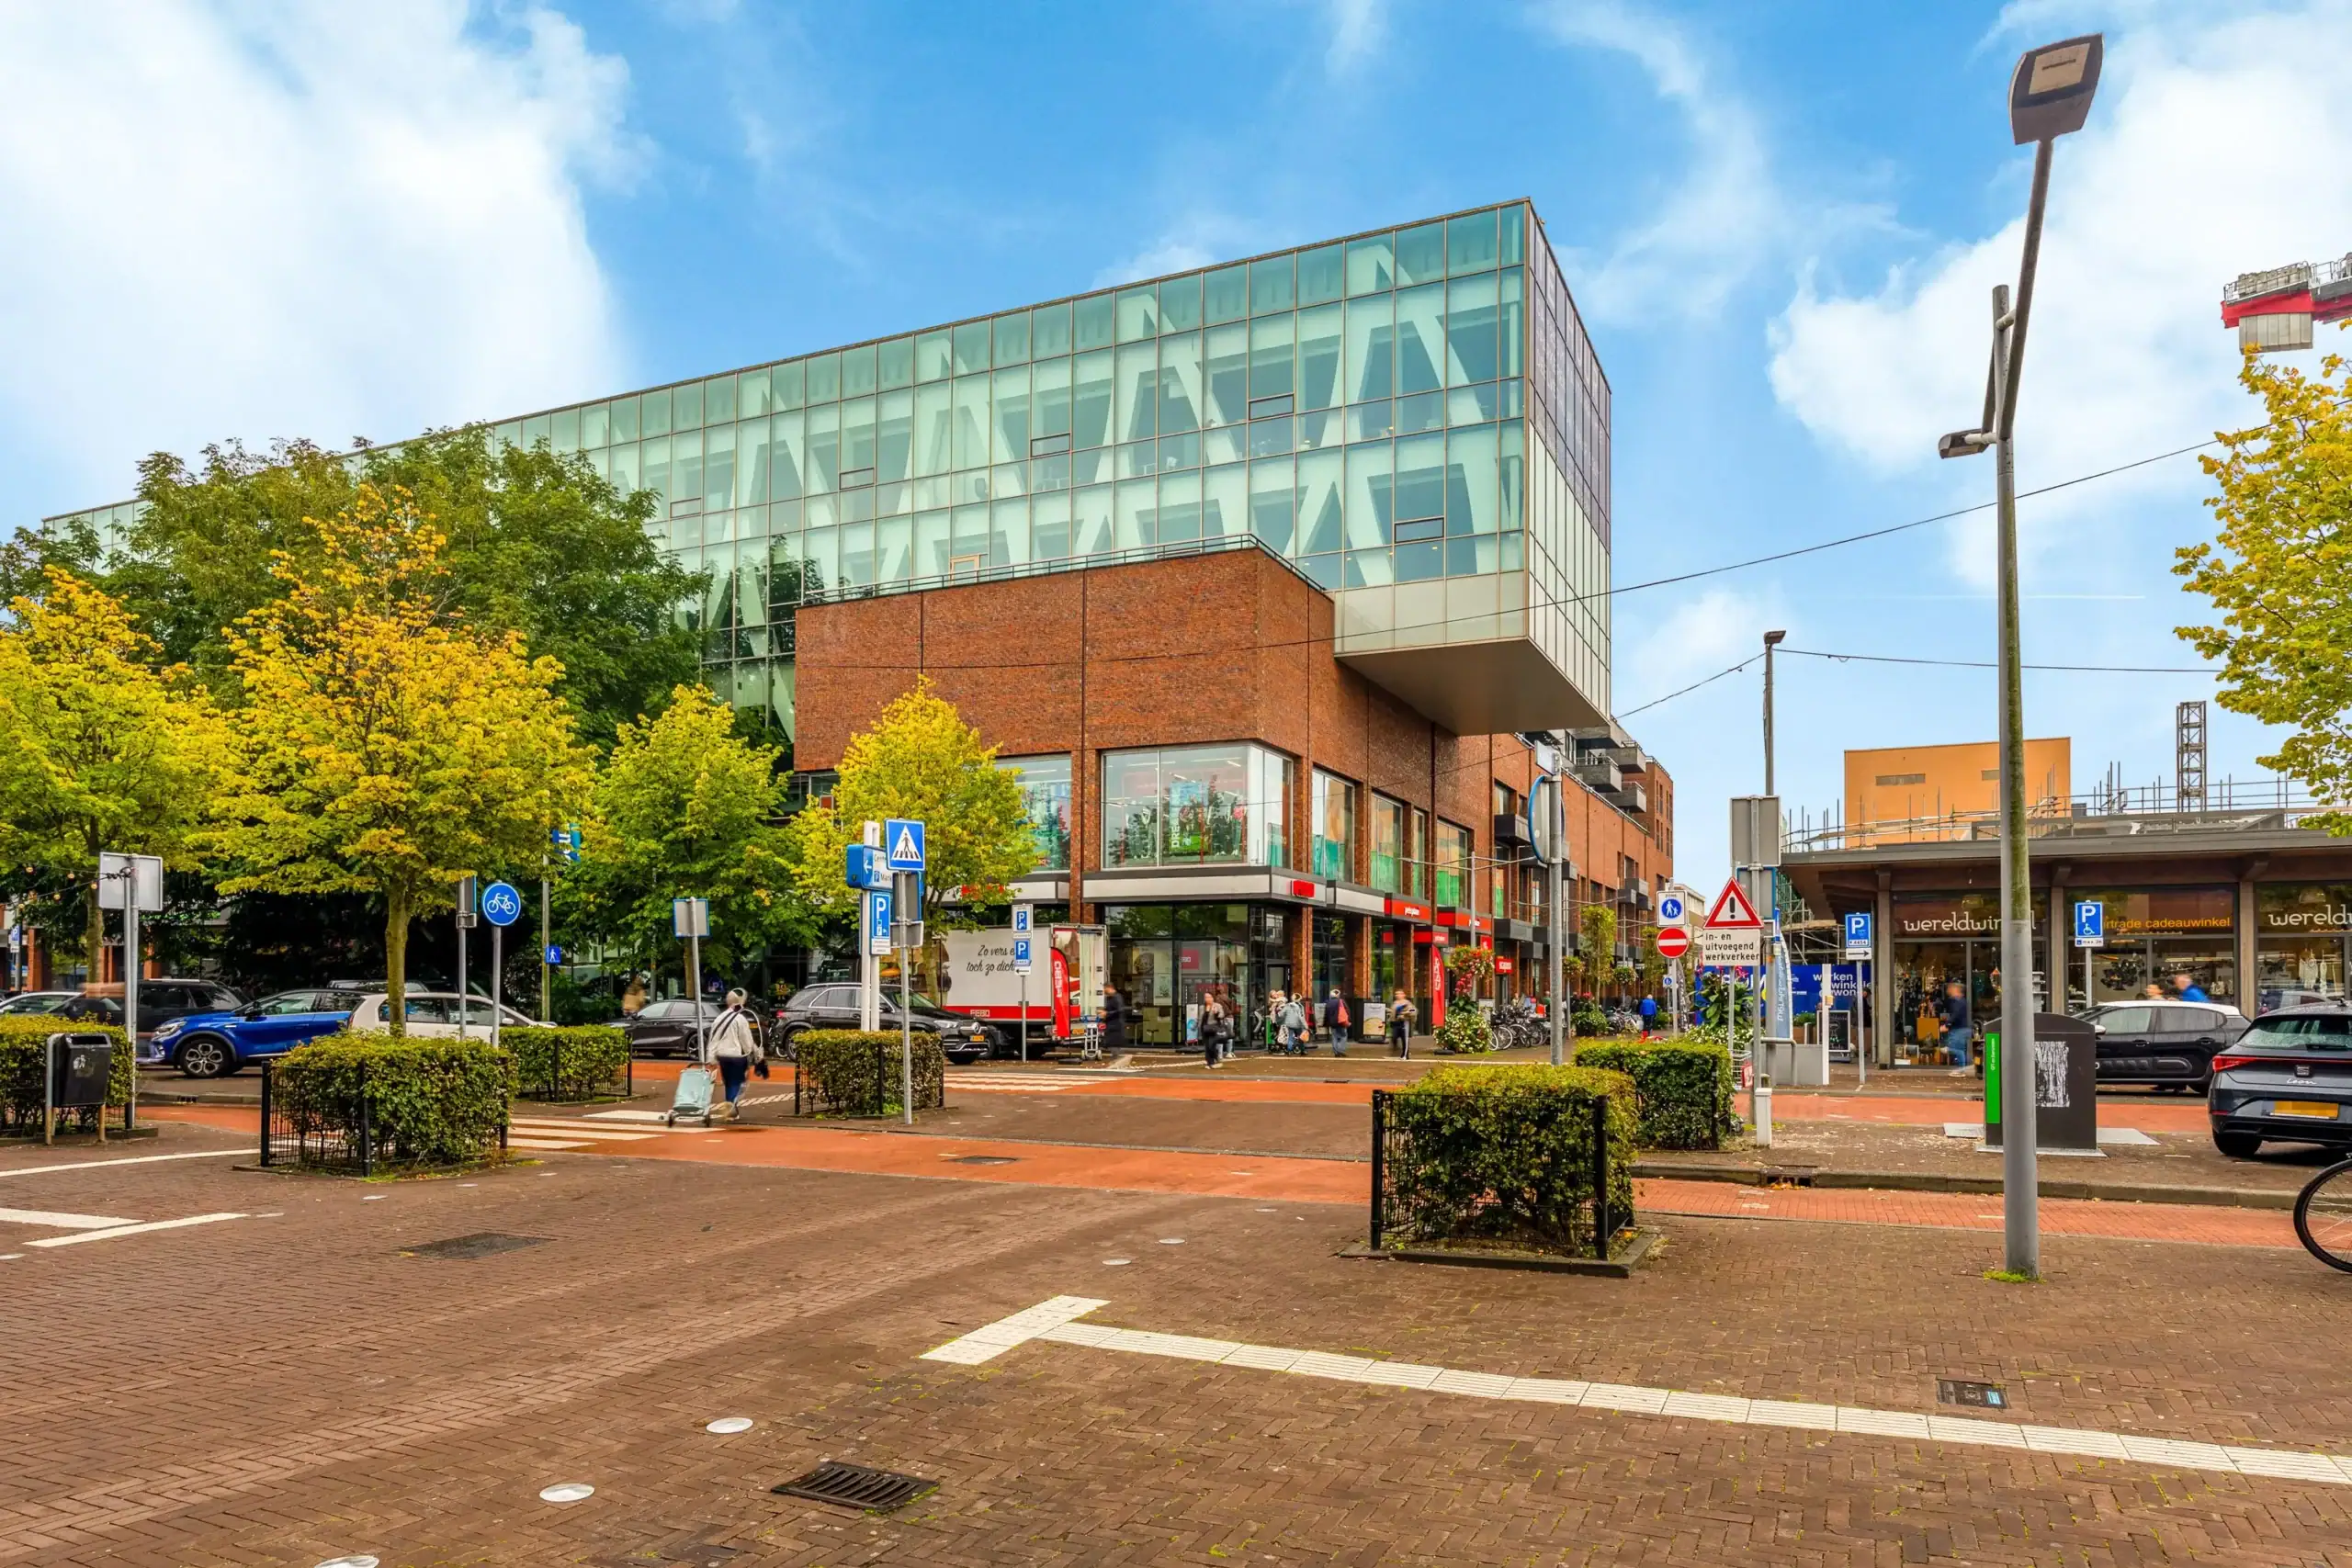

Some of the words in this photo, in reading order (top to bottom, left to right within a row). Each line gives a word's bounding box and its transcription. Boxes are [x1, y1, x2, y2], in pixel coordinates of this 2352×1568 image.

[876, 897, 887, 919] P
[2082, 905, 2096, 923] P
[1851, 917, 1864, 934] P
[1904, 910, 2037, 931] wereldwinl
[2145, 918, 2231, 929] cadeauwinkel
[978, 944, 989, 956] Zo
[990, 947, 1008, 956] vers
[1018, 942, 1026, 956] P
[1705, 942, 1754, 952] uitvoegend
[1705, 953, 1760, 961] werkverkeer
[967, 960, 984, 972] toch
